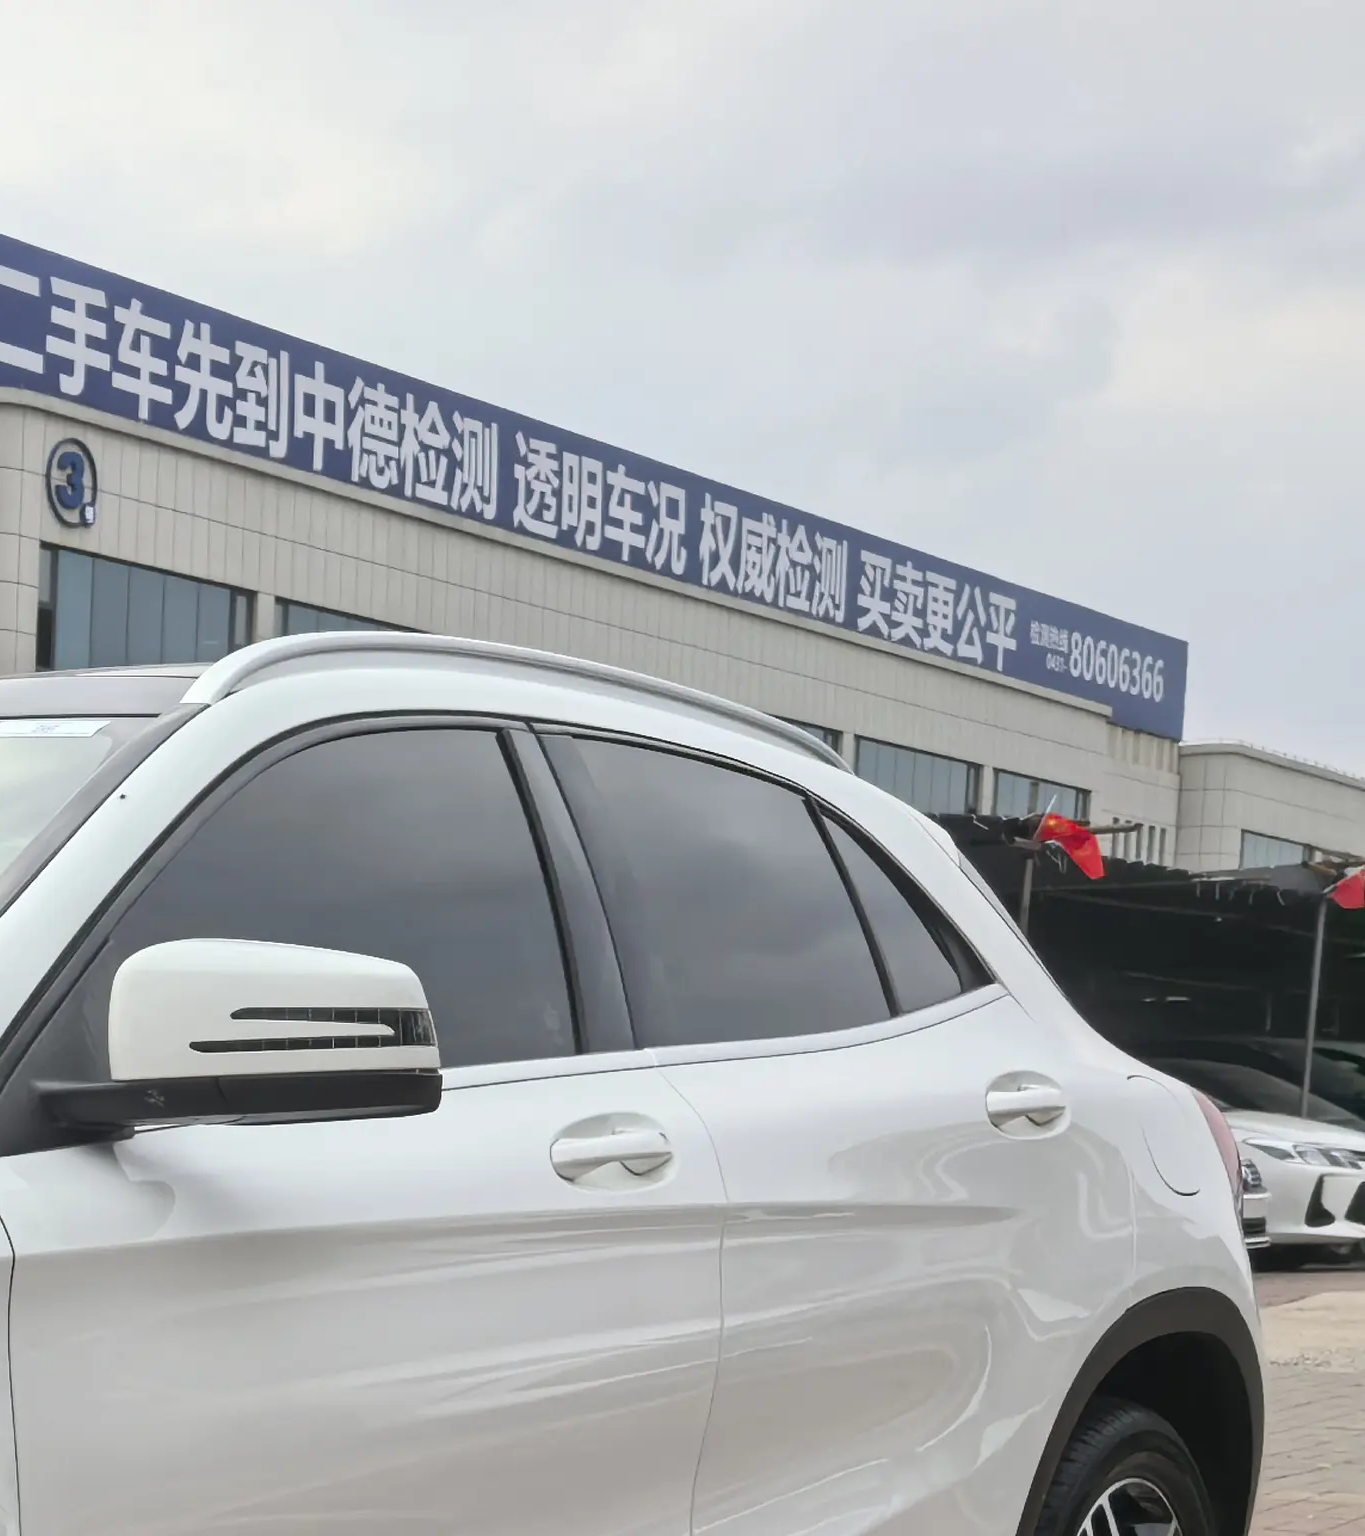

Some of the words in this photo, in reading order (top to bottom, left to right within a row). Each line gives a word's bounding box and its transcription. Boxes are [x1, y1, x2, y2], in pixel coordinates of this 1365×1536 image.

[55, 451, 85, 510] 3
[513, 431, 685, 574] 透明车况
[699, 492, 848, 619] 权威检测
[857, 549, 1016, 672] 买卖更公平
[1069, 632, 1164, 702] 80606366
